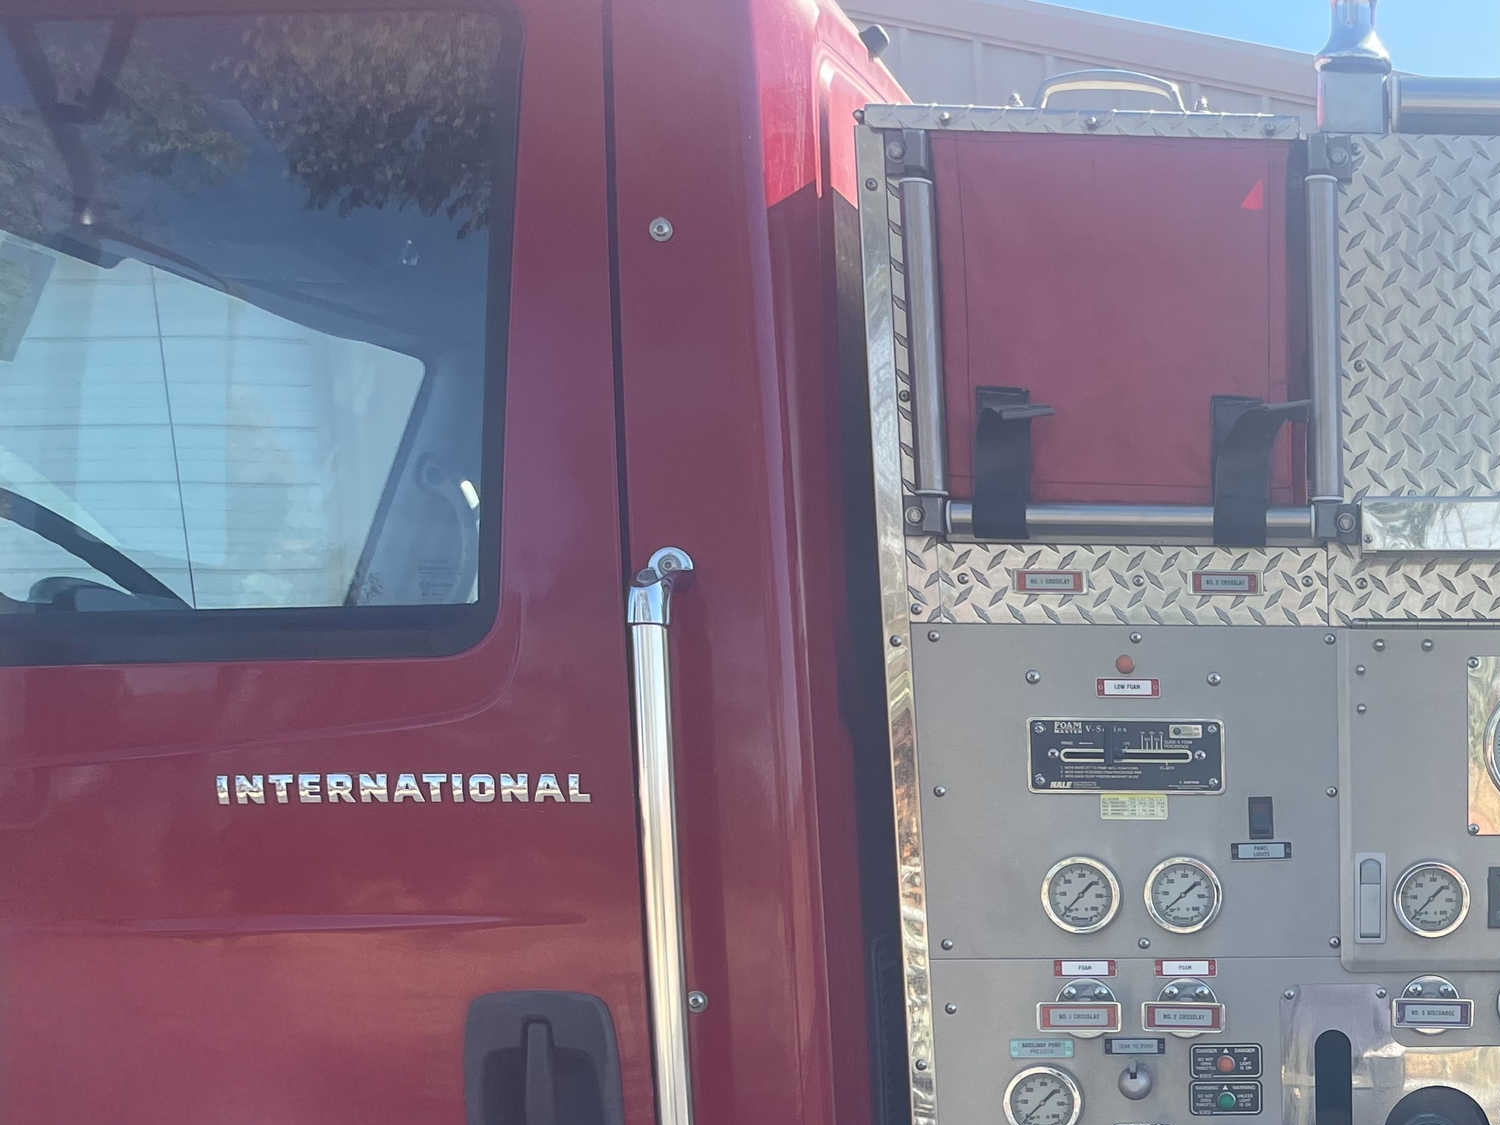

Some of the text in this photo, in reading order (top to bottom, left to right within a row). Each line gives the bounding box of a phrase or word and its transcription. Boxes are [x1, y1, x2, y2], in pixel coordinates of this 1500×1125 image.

[1054, 721, 1082, 729] FOAM
[216, 773, 592, 805] INTERNATIONAL
[1050, 781, 1073, 789] HALE
